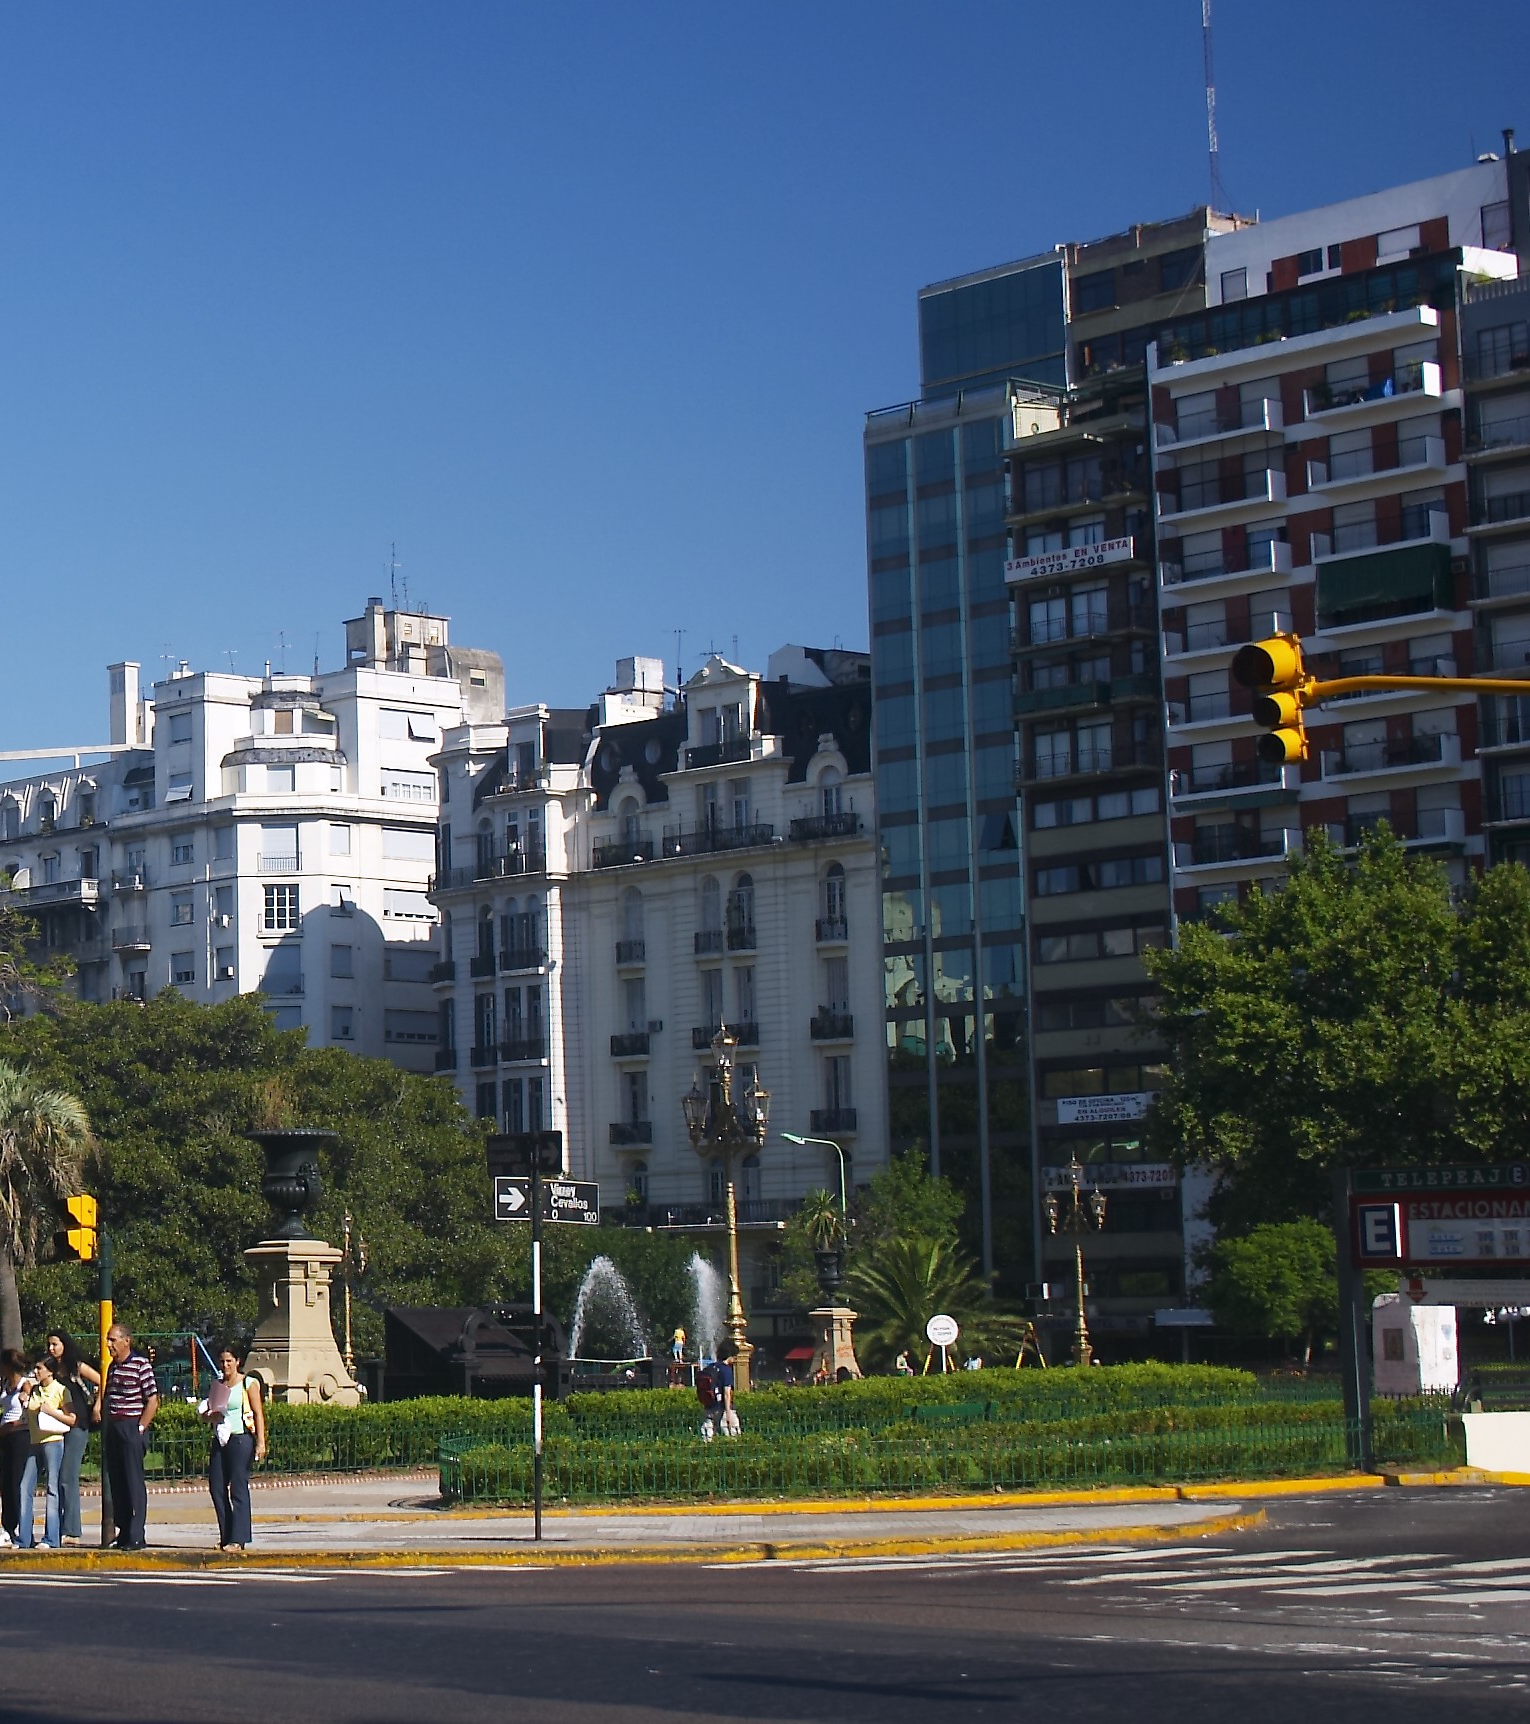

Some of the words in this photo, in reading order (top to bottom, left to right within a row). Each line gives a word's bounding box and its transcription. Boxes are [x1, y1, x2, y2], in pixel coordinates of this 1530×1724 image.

[1015, 553, 1067, 570] Ambientes
[1074, 549, 1088, 558] EN
[1093, 539, 1128, 554] VENTA
[551, 1209, 559, 1219] 0
[583, 1211, 597, 1222] 100
[1364, 1210, 1391, 1251] E
